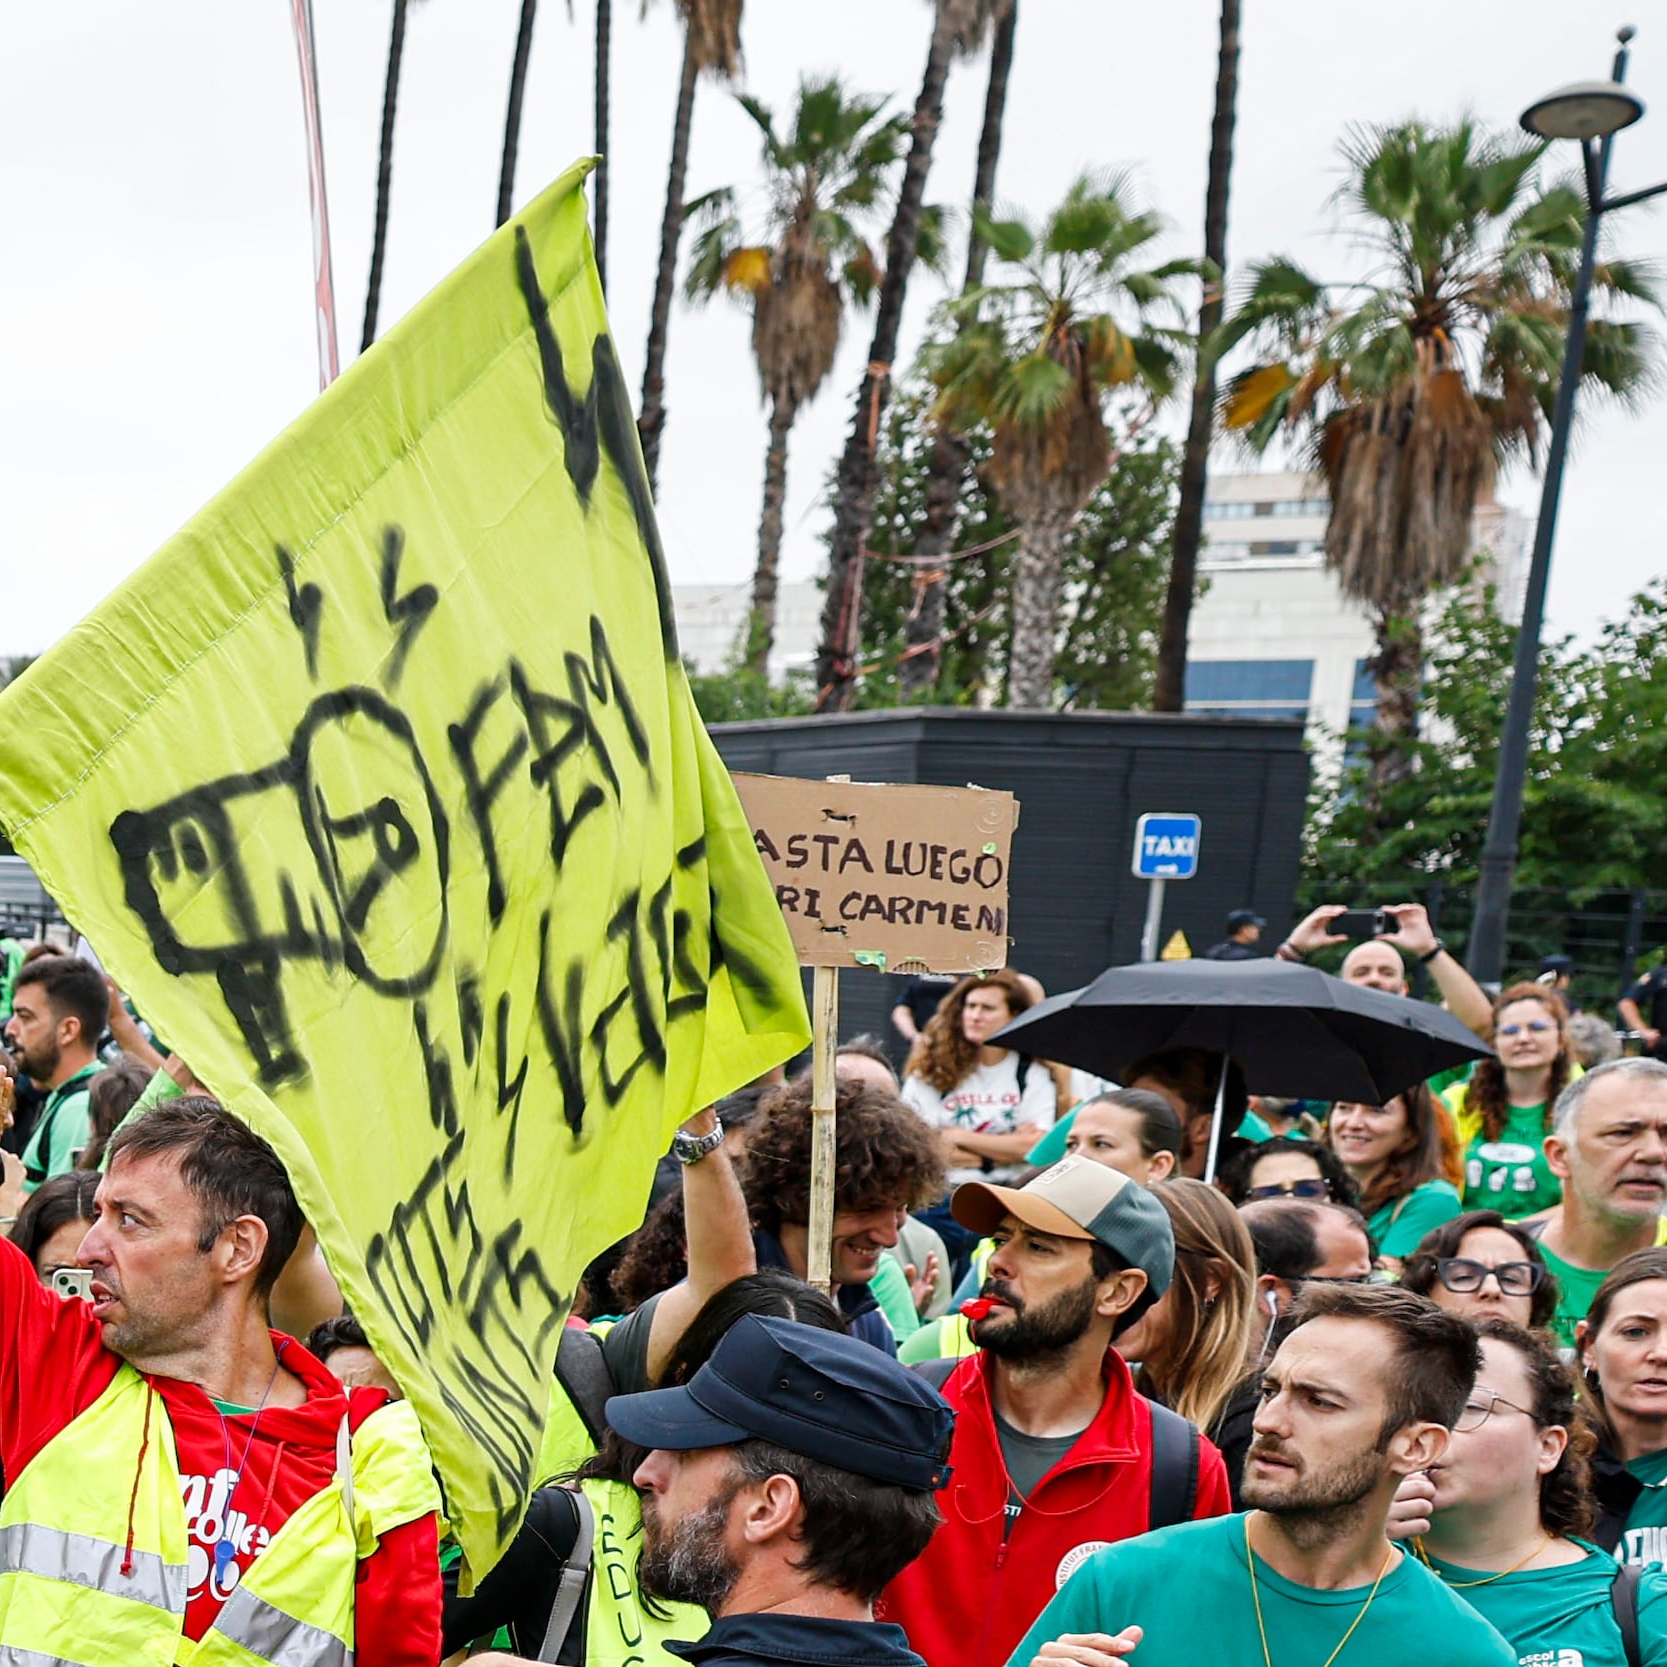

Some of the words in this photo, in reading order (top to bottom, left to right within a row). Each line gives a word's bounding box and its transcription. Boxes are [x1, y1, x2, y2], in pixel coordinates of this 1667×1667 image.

[754, 827, 874, 876] ASTA
[884, 839, 1004, 888] LUEGO
[1142, 835, 1195, 858] TAXI
[776, 883, 821, 919] RI
[838, 890, 1006, 937] CARMEN
